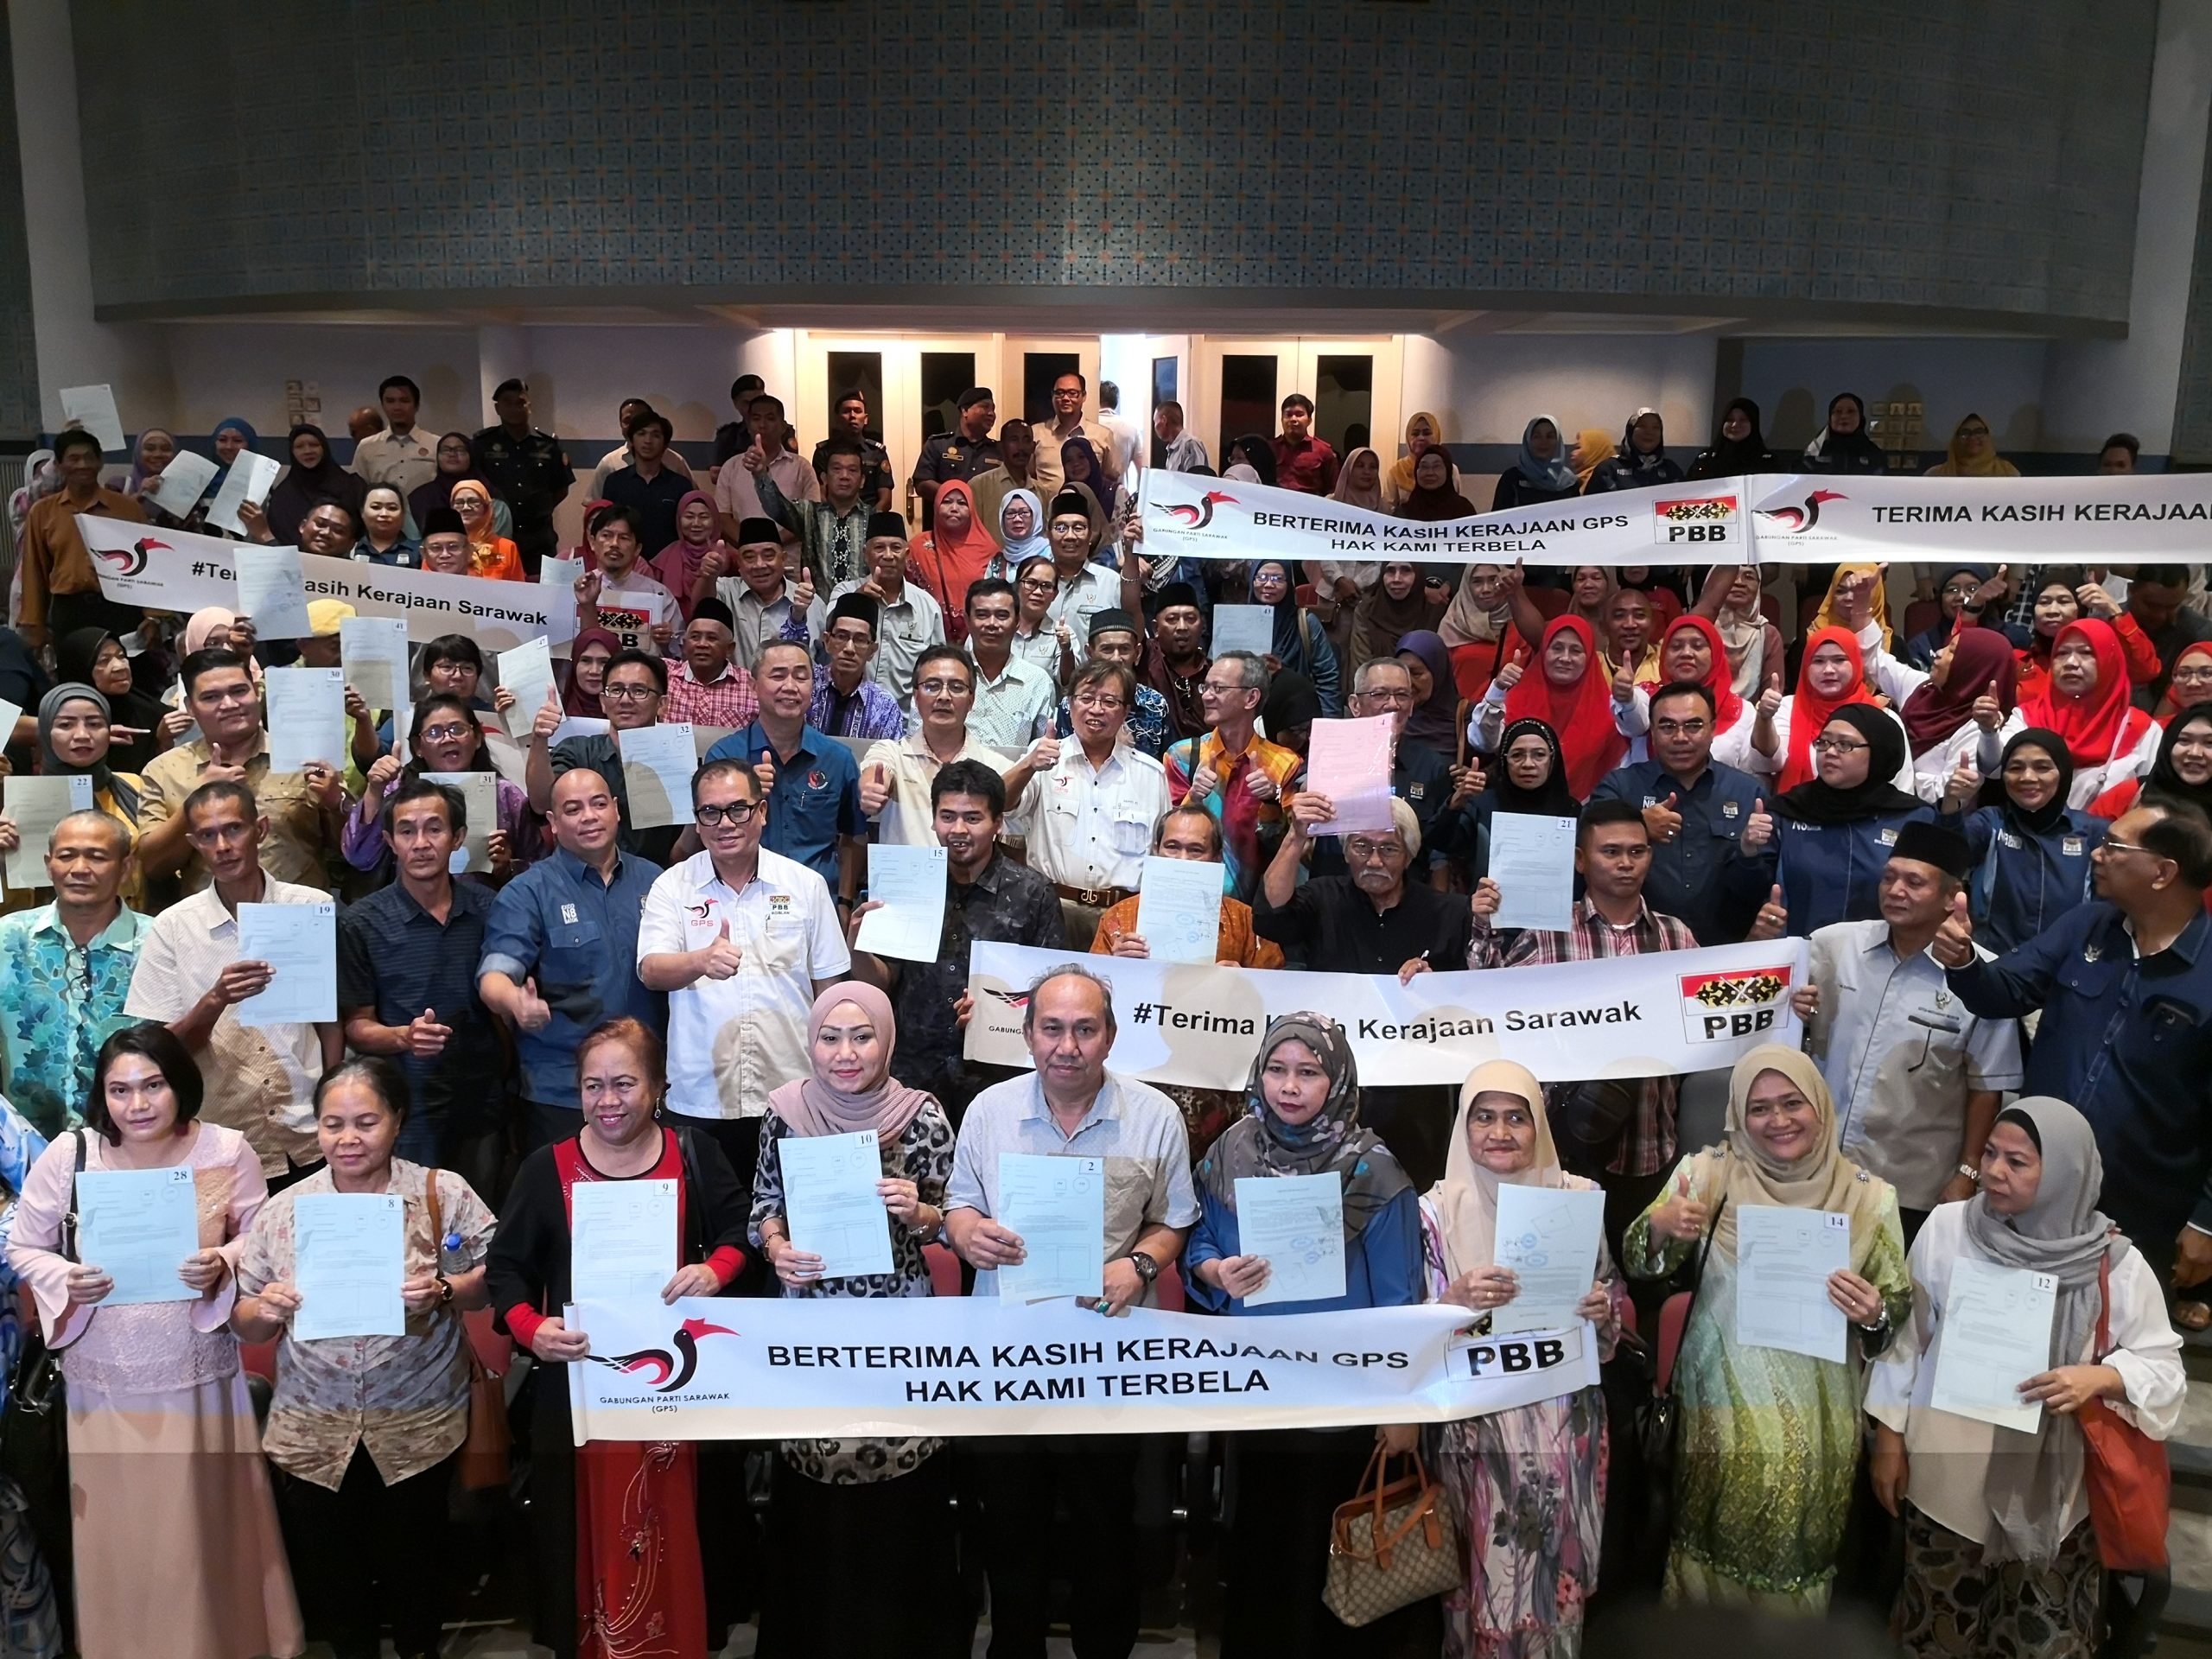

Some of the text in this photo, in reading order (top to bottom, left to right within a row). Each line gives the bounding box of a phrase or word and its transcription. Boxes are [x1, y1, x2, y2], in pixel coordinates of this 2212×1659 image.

[1872, 503, 2212, 524] TERIMA KASIH KERAJAA
[1253, 512, 1630, 538] BERTERIMA KASIH KERAJAAN GPS
[1669, 524, 1726, 542] PBB
[1331, 539, 1546, 552] HAK KAMI TERBELA
[304, 580, 349, 596] asih
[357, 584, 451, 611] Kerajaan
[457, 600, 548, 626] Sarawak
[1560, 819, 1571, 828] 21
[1133, 1002, 1255, 1035] #Terima
[1359, 1014, 1494, 1044] Kerajaan
[1505, 1001, 1642, 1032] Sarawak
[1703, 1009, 1774, 1039] PBB
[988, 1025, 1025, 1035] GABUNG
[861, 1134, 872, 1145] 10
[1088, 1162, 1095, 1171] 2
[174, 1170, 188, 1181] 28
[663, 1182, 669, 1192] 9
[388, 1199, 395, 1208] 8
[1832, 1216, 1844, 1227] 14
[2039, 1277, 2050, 1289] 12
[767, 1337, 1409, 1370] BERTERIMA KASIH KERAJAAN GPS
[1467, 1339, 1564, 1376] PBB
[906, 1369, 1270, 1402] HAK KAMI TERBELA
[600, 1393, 730, 1404] GABUNGAN PARTI SARAWAK
[652, 1404, 677, 1414] (GPS)
